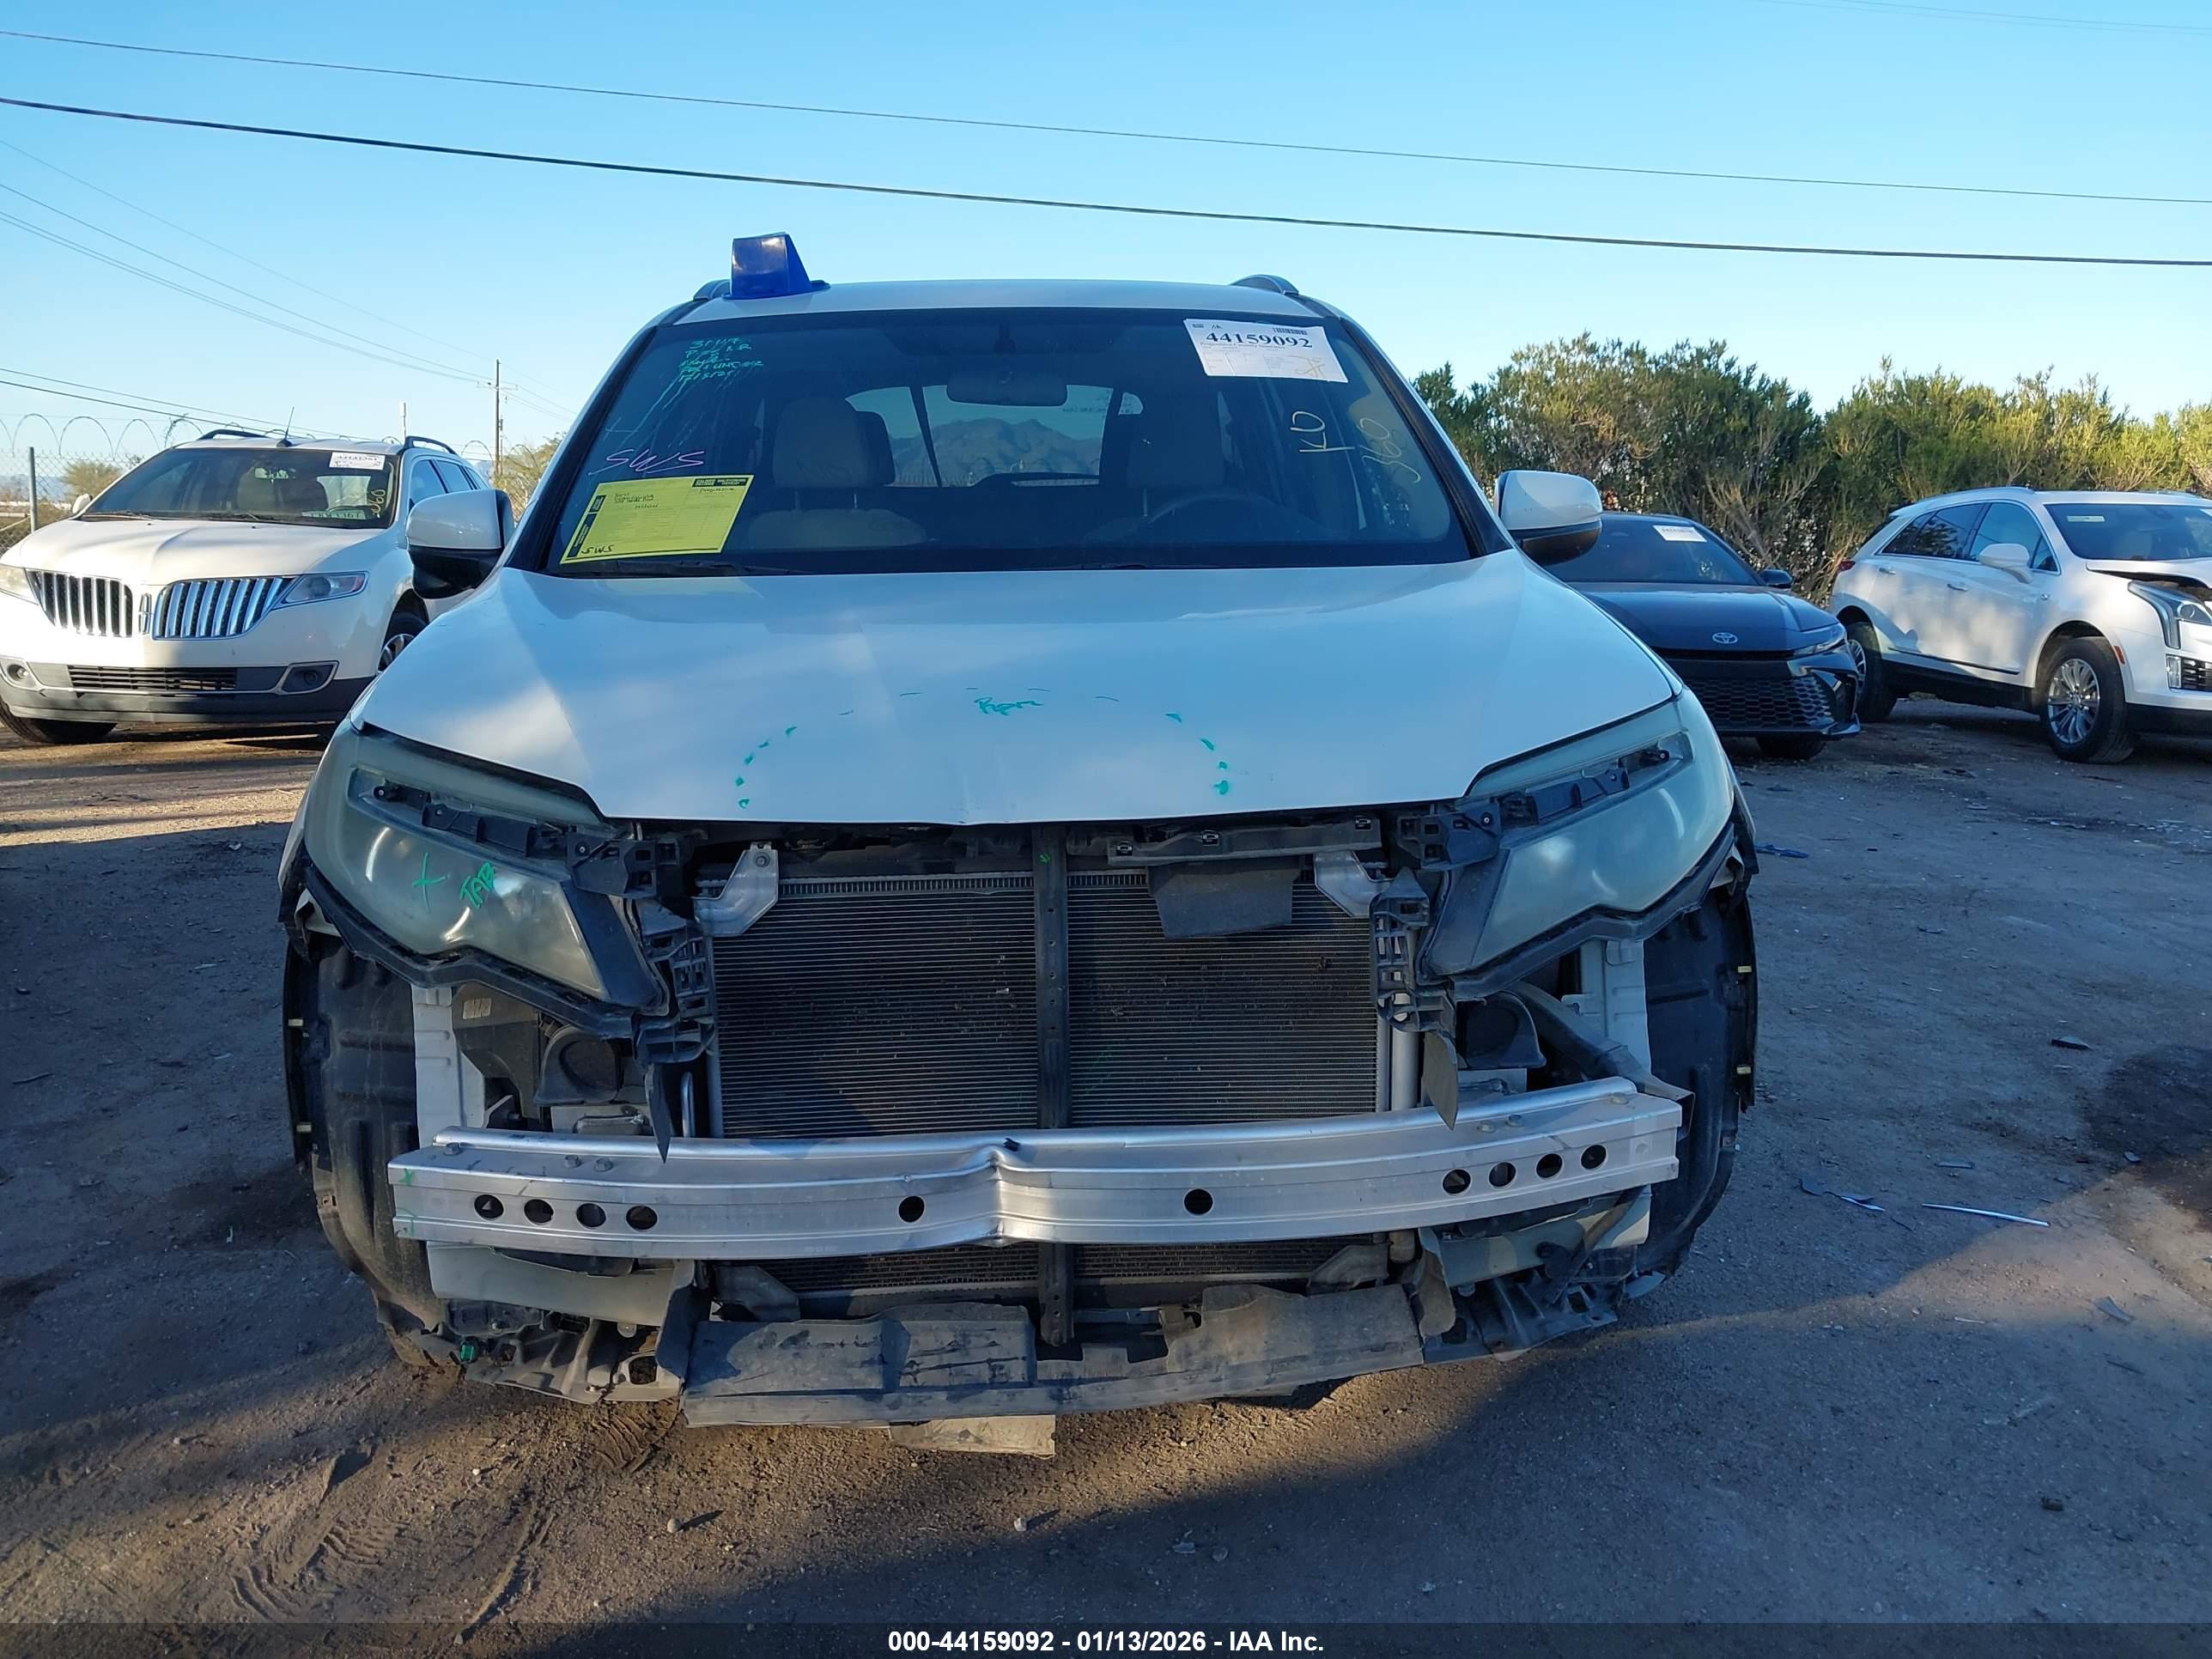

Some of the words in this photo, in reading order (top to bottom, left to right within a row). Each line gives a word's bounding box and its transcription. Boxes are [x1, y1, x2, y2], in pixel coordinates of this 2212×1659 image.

[1206, 332, 1313, 349] 44159092
[587, 447, 705, 476] SWS
[1356, 417, 1421, 483] 360
[580, 544, 614, 555] SWS
